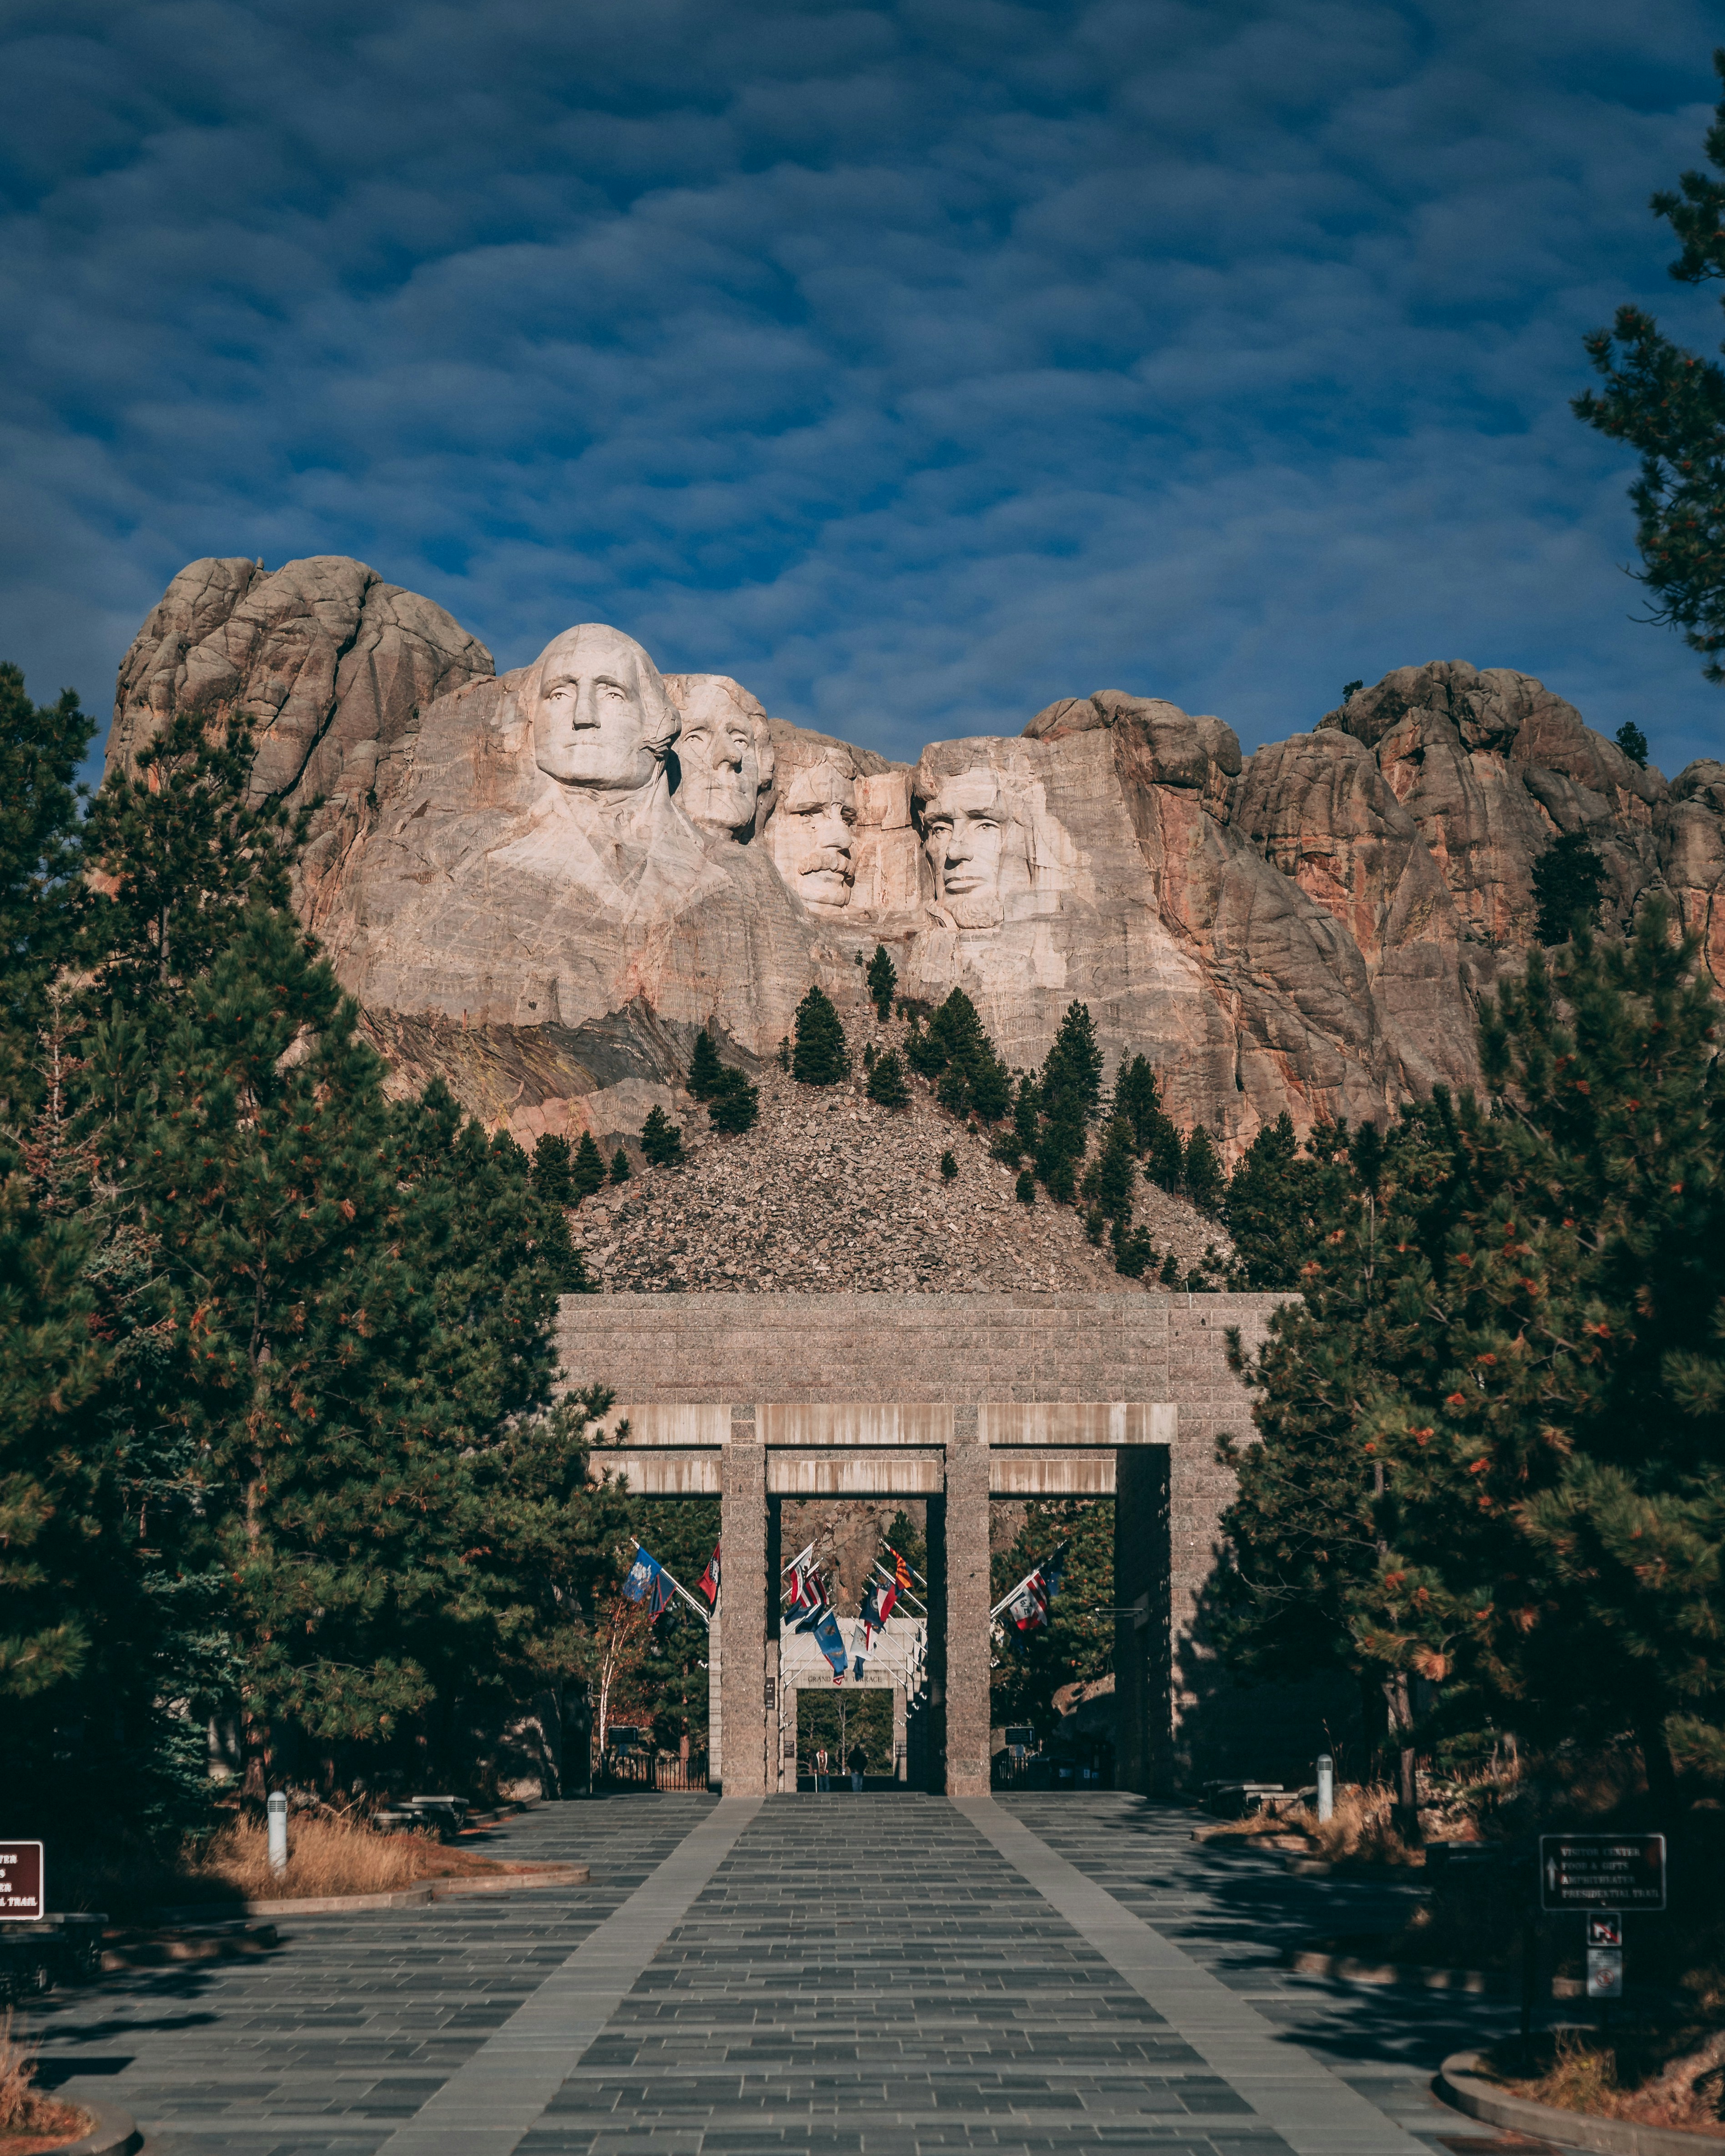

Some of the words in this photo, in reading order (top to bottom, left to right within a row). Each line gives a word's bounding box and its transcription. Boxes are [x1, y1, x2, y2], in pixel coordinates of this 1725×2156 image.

[1561, 1848, 1599, 1856] VISITOR
[1602, 1848, 1640, 1856] CENTER
[1601, 1862, 1629, 1870] GIFTS
[1561, 1875, 1635, 1884] AMPHITHEATER
[1562, 1890, 1631, 1898] PRESIDENTIAL
[1633, 1890, 1660, 1898] TRAIL
[7, 1897, 38, 1906] TRAIL
